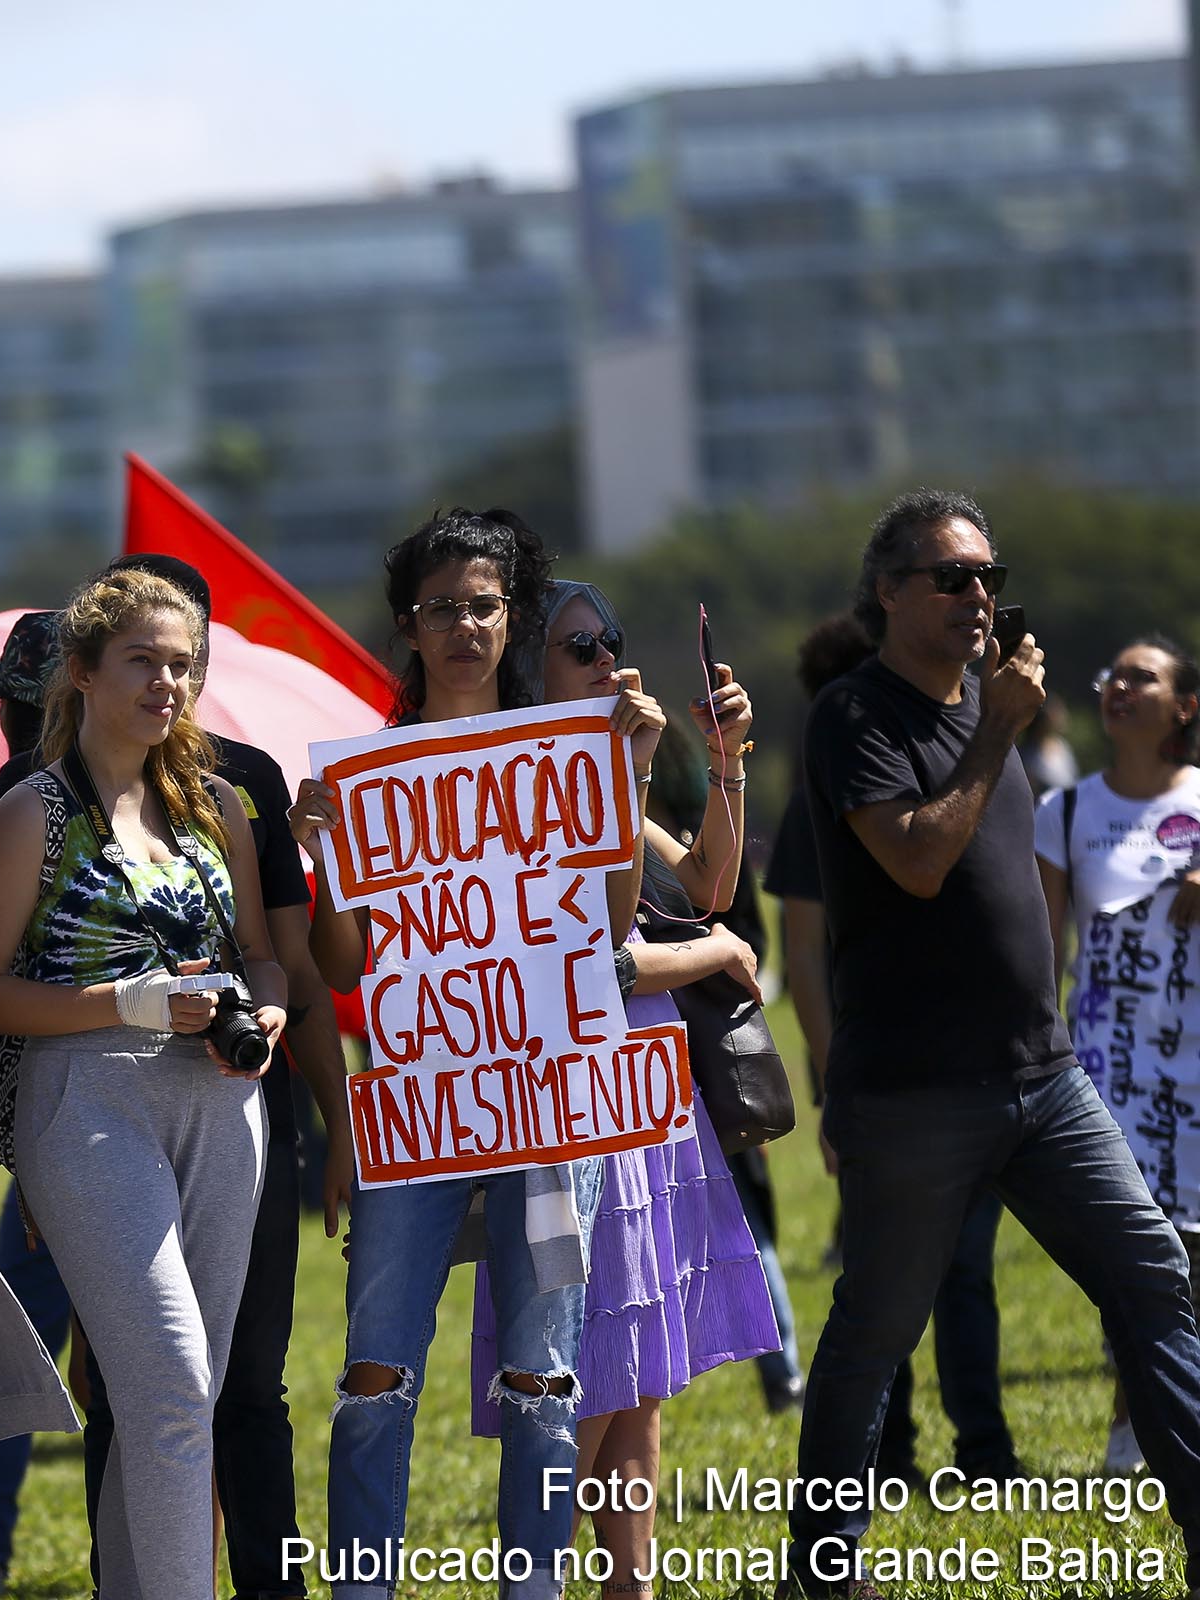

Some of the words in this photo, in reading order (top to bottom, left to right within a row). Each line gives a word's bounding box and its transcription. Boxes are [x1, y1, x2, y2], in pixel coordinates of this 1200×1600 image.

[89, 804, 109, 836] Nikon
[350, 740, 605, 878] EDUCAÇÃO
[399, 868, 495, 960] NÃO
[515, 854, 558, 946] É
[370, 957, 543, 1065] GASTO,
[565, 928, 607, 1045] É
